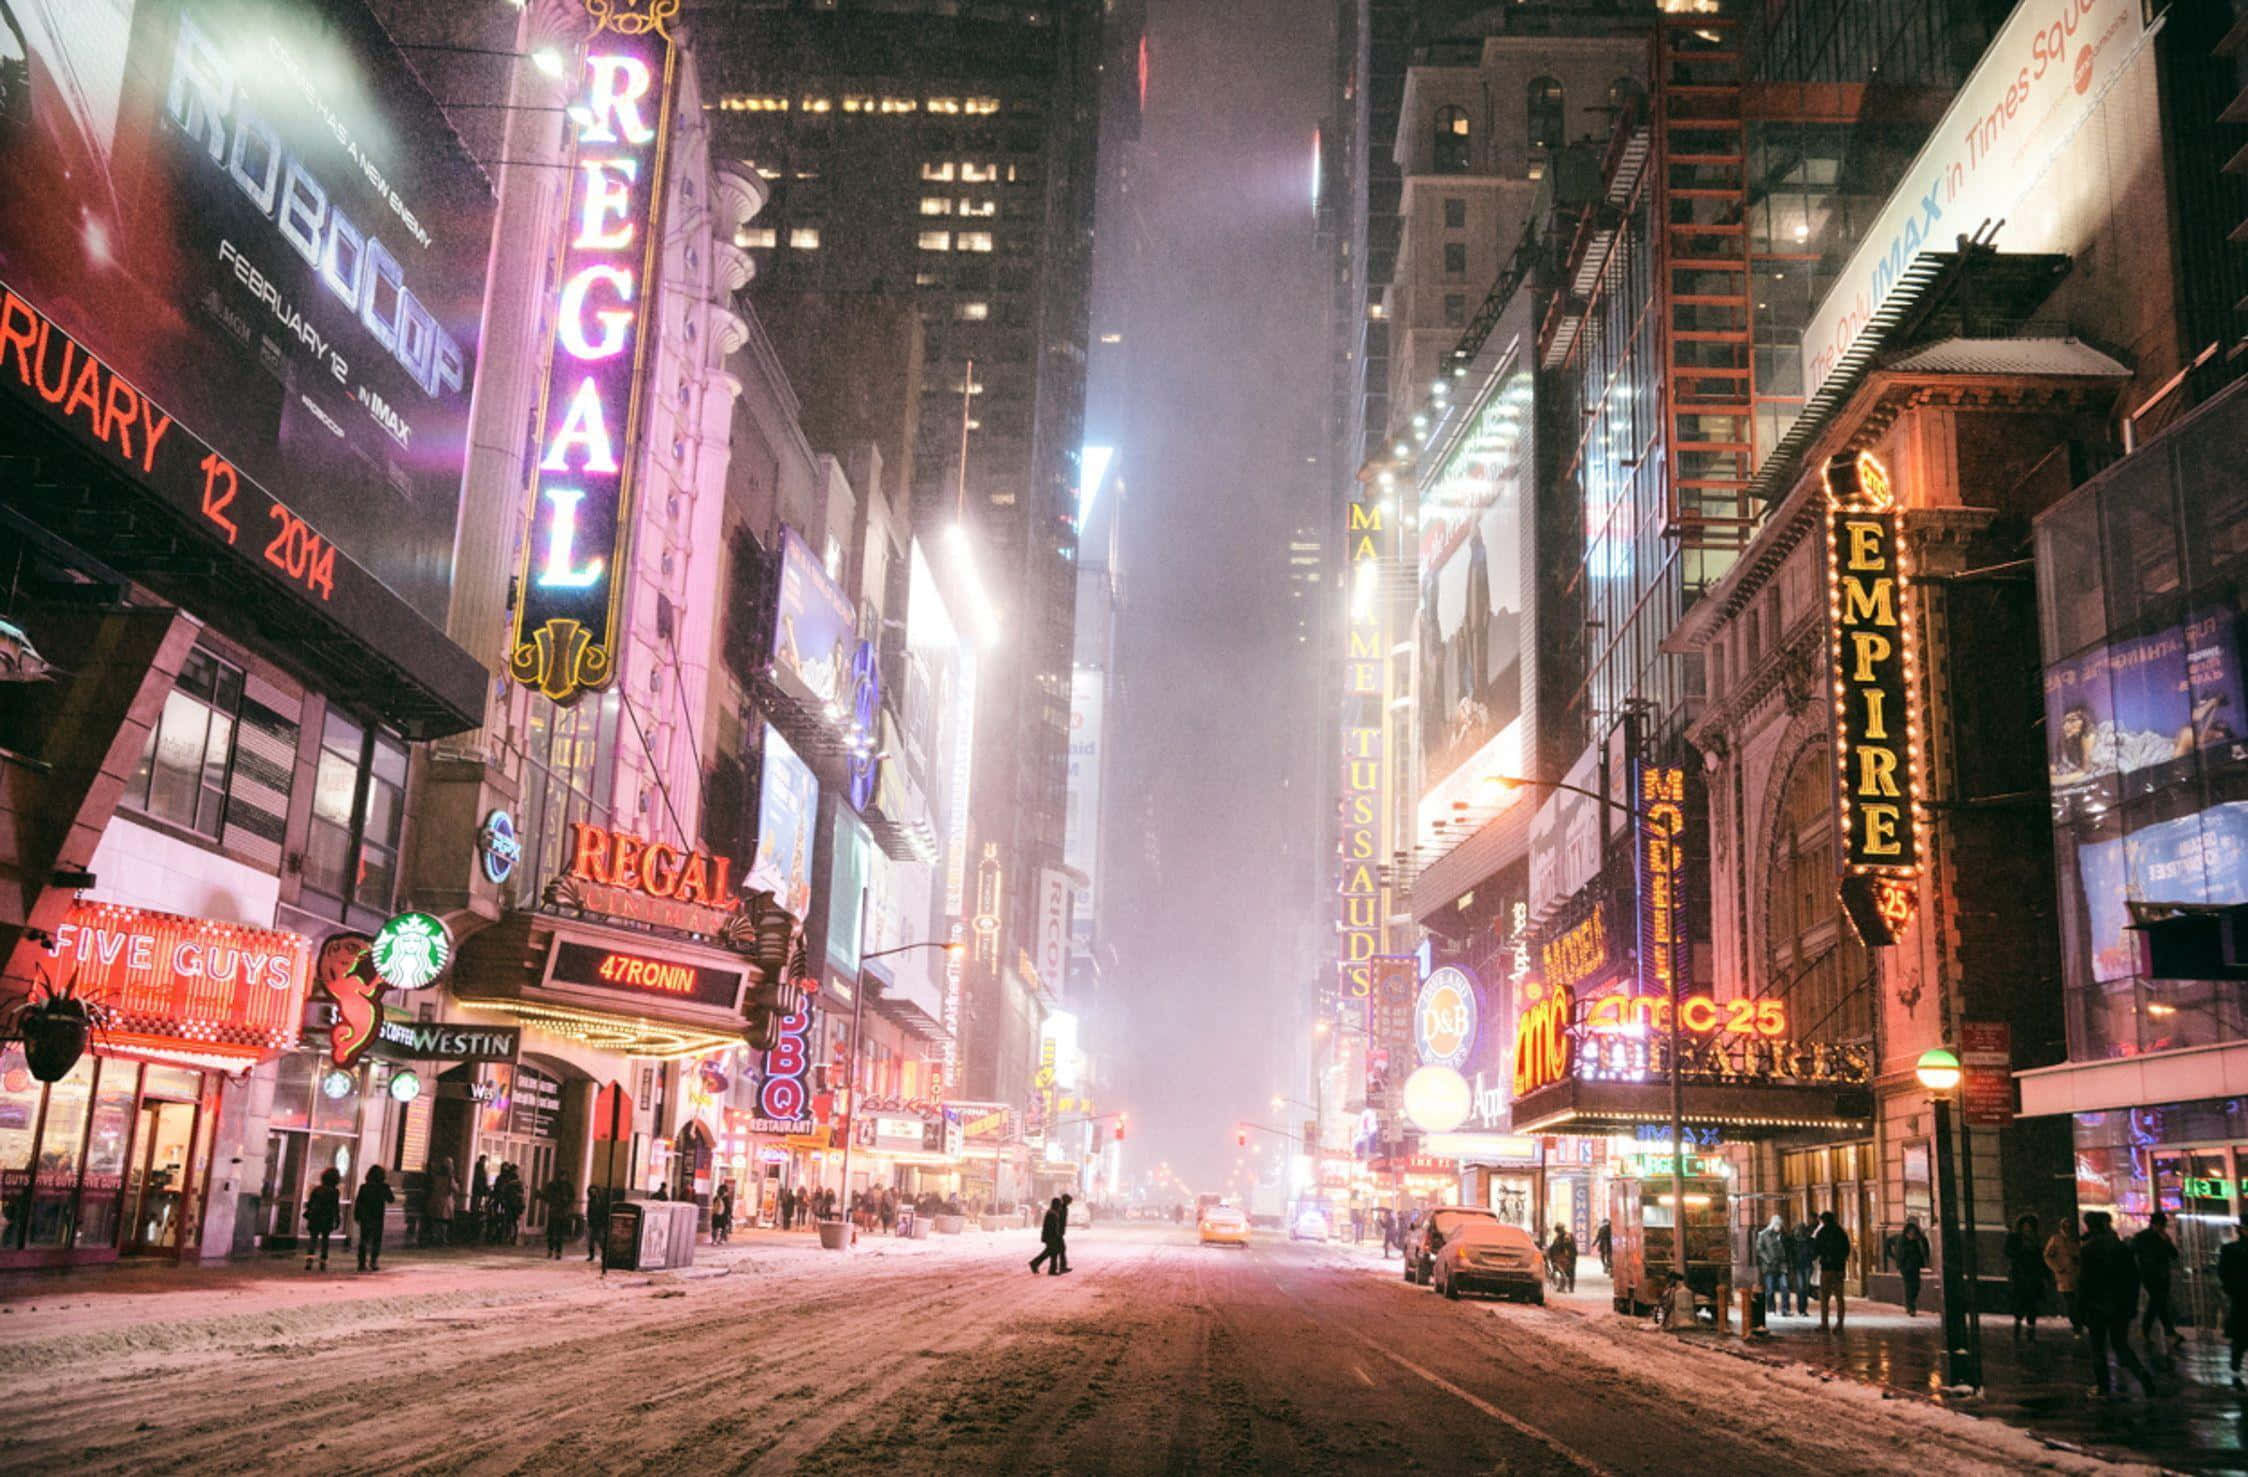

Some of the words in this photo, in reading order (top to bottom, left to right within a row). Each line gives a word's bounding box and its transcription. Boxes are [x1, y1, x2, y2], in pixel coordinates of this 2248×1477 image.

[167, 8, 463, 399] ROBOCOP
[347, 141, 358, 162] A
[359, 153, 390, 198] NEW
[389, 191, 432, 249] ENEMY
[1871, 176, 1943, 309] IMAX
[1945, 161, 1964, 204] in
[1965, 66, 2029, 170] Times
[219, 239, 329, 360] FEBRUARY
[330, 351, 349, 384] 12
[538, 53, 654, 588] REGAL
[0, 291, 171, 473] RUARY
[264, 502, 336, 600] 2014
[358, 384, 372, 407] IN
[371, 392, 412, 446] IMAX
[1350, 503, 1383, 692] MAME
[1843, 521, 1901, 855] EMPIRE
[570, 822, 738, 912] REGAL
[586, 889, 724, 932] CINEMAS
[1883, 887, 1907, 919] 25
[48, 923, 155, 970] FIVE
[173, 940, 291, 990] GUYS
[386, 1022, 415, 1047] COFFEE
[414, 1026, 513, 1055] WESTIN
[762, 994, 809, 1121] BBQ
[1423, 1005, 1469, 1040] D&B
[1513, 983, 1568, 1098] amc
[1586, 994, 1718, 1032] amc
[1725, 998, 1786, 1035] 25
[751, 1118, 814, 1134] RESTAURANT
[1635, 1124, 1721, 1145] IMAX
